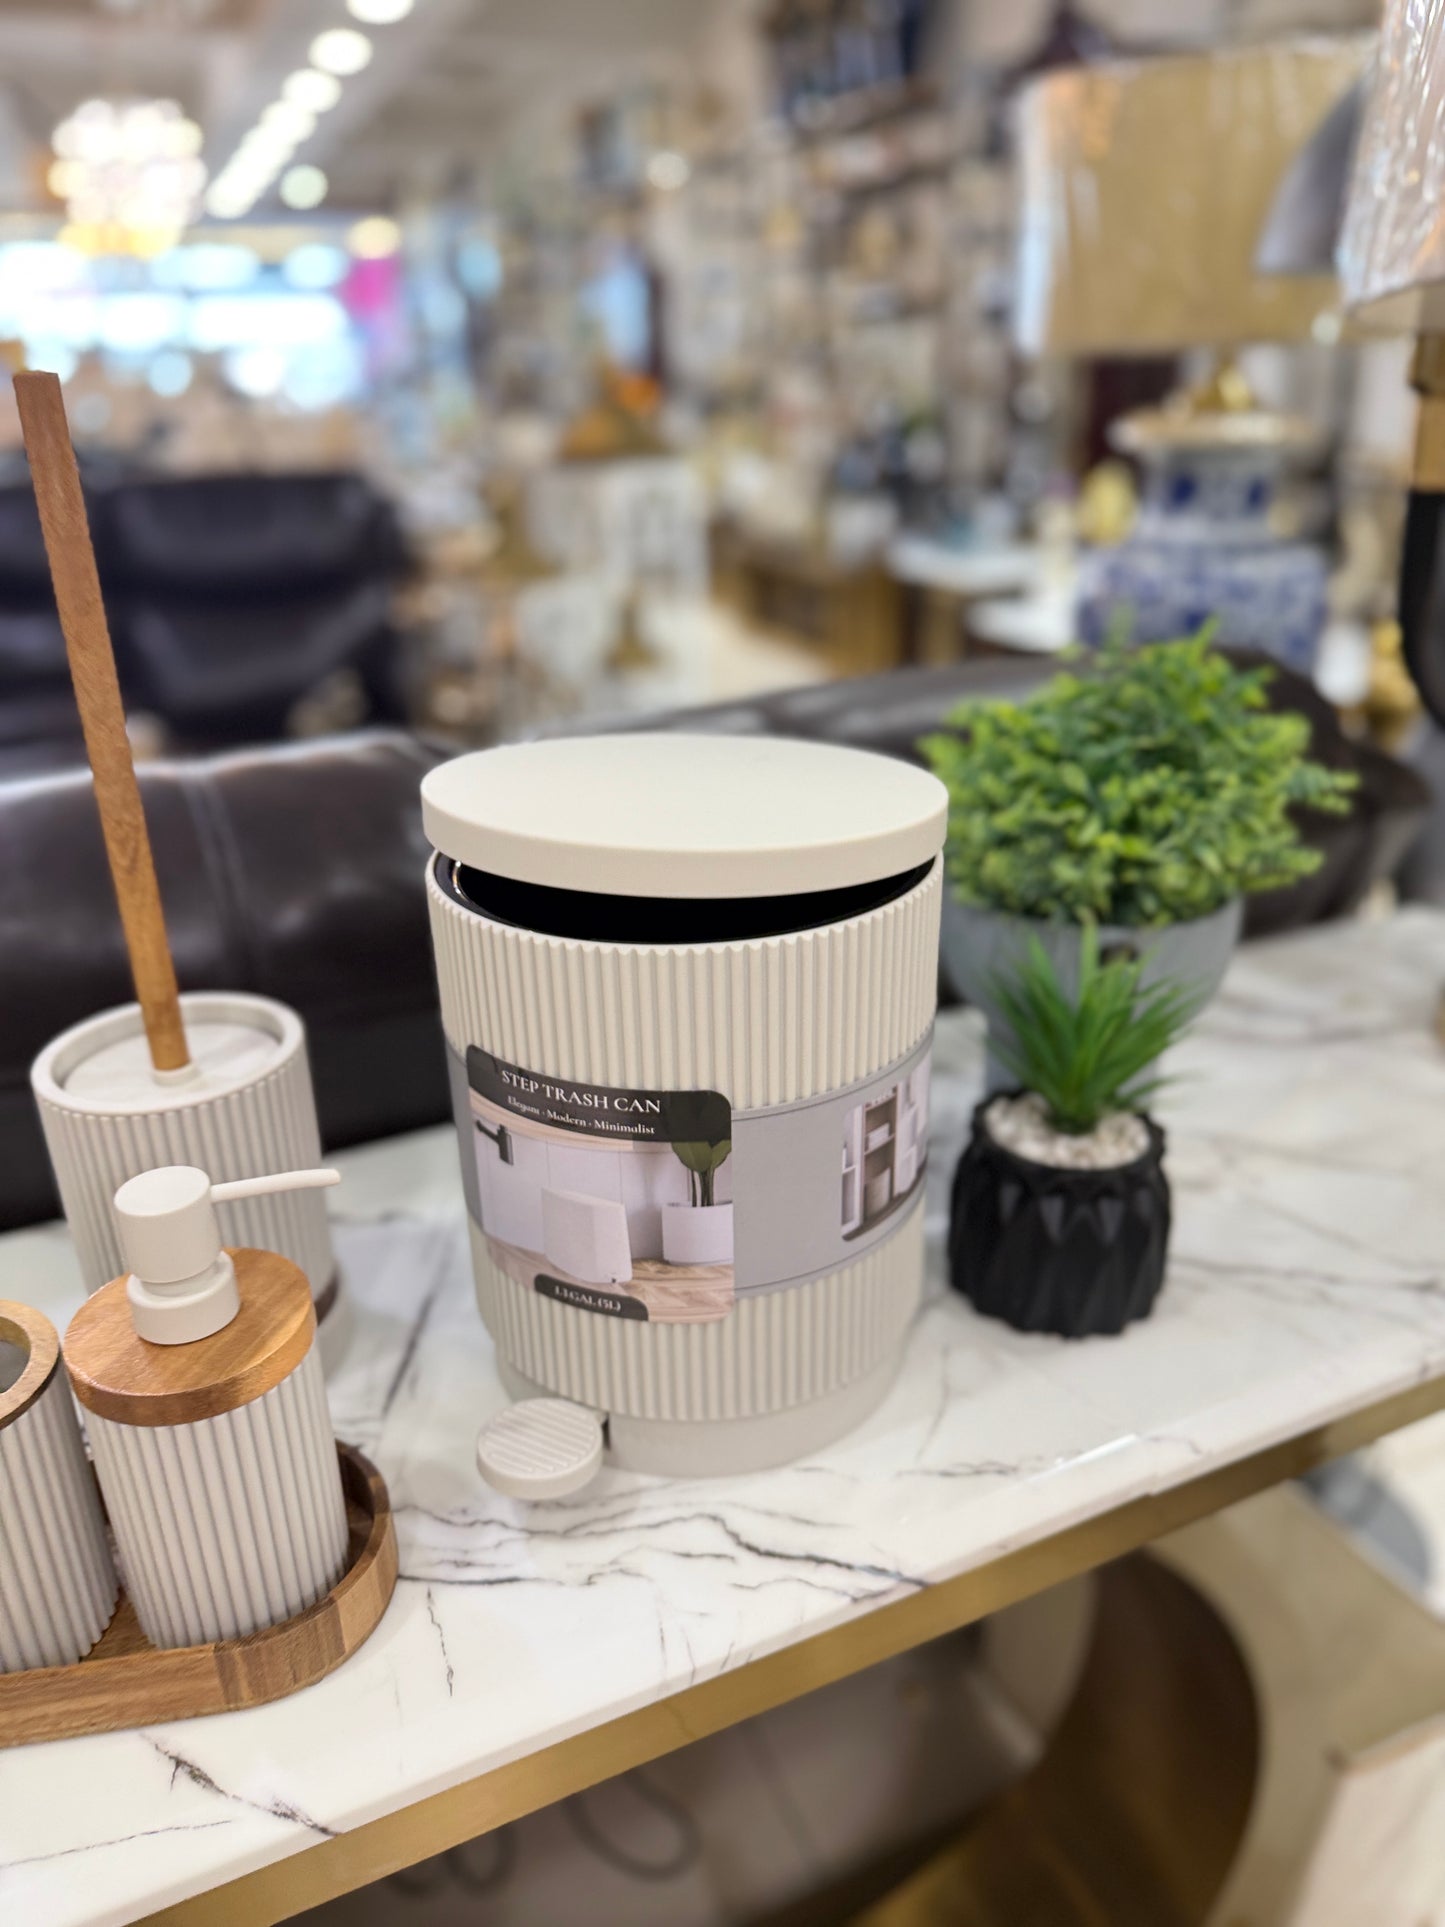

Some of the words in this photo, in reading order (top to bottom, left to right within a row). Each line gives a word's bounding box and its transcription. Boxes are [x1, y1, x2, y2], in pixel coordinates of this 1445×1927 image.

[502, 1070, 539, 1093] STEP
[542, 1084, 609, 1109] TRASH
[614, 1097, 661, 1113] CAN
[508, 1095, 540, 1115] Elegant
[546, 1109, 587, 1126] Modern
[594, 1120, 655, 1135] Minimalist
